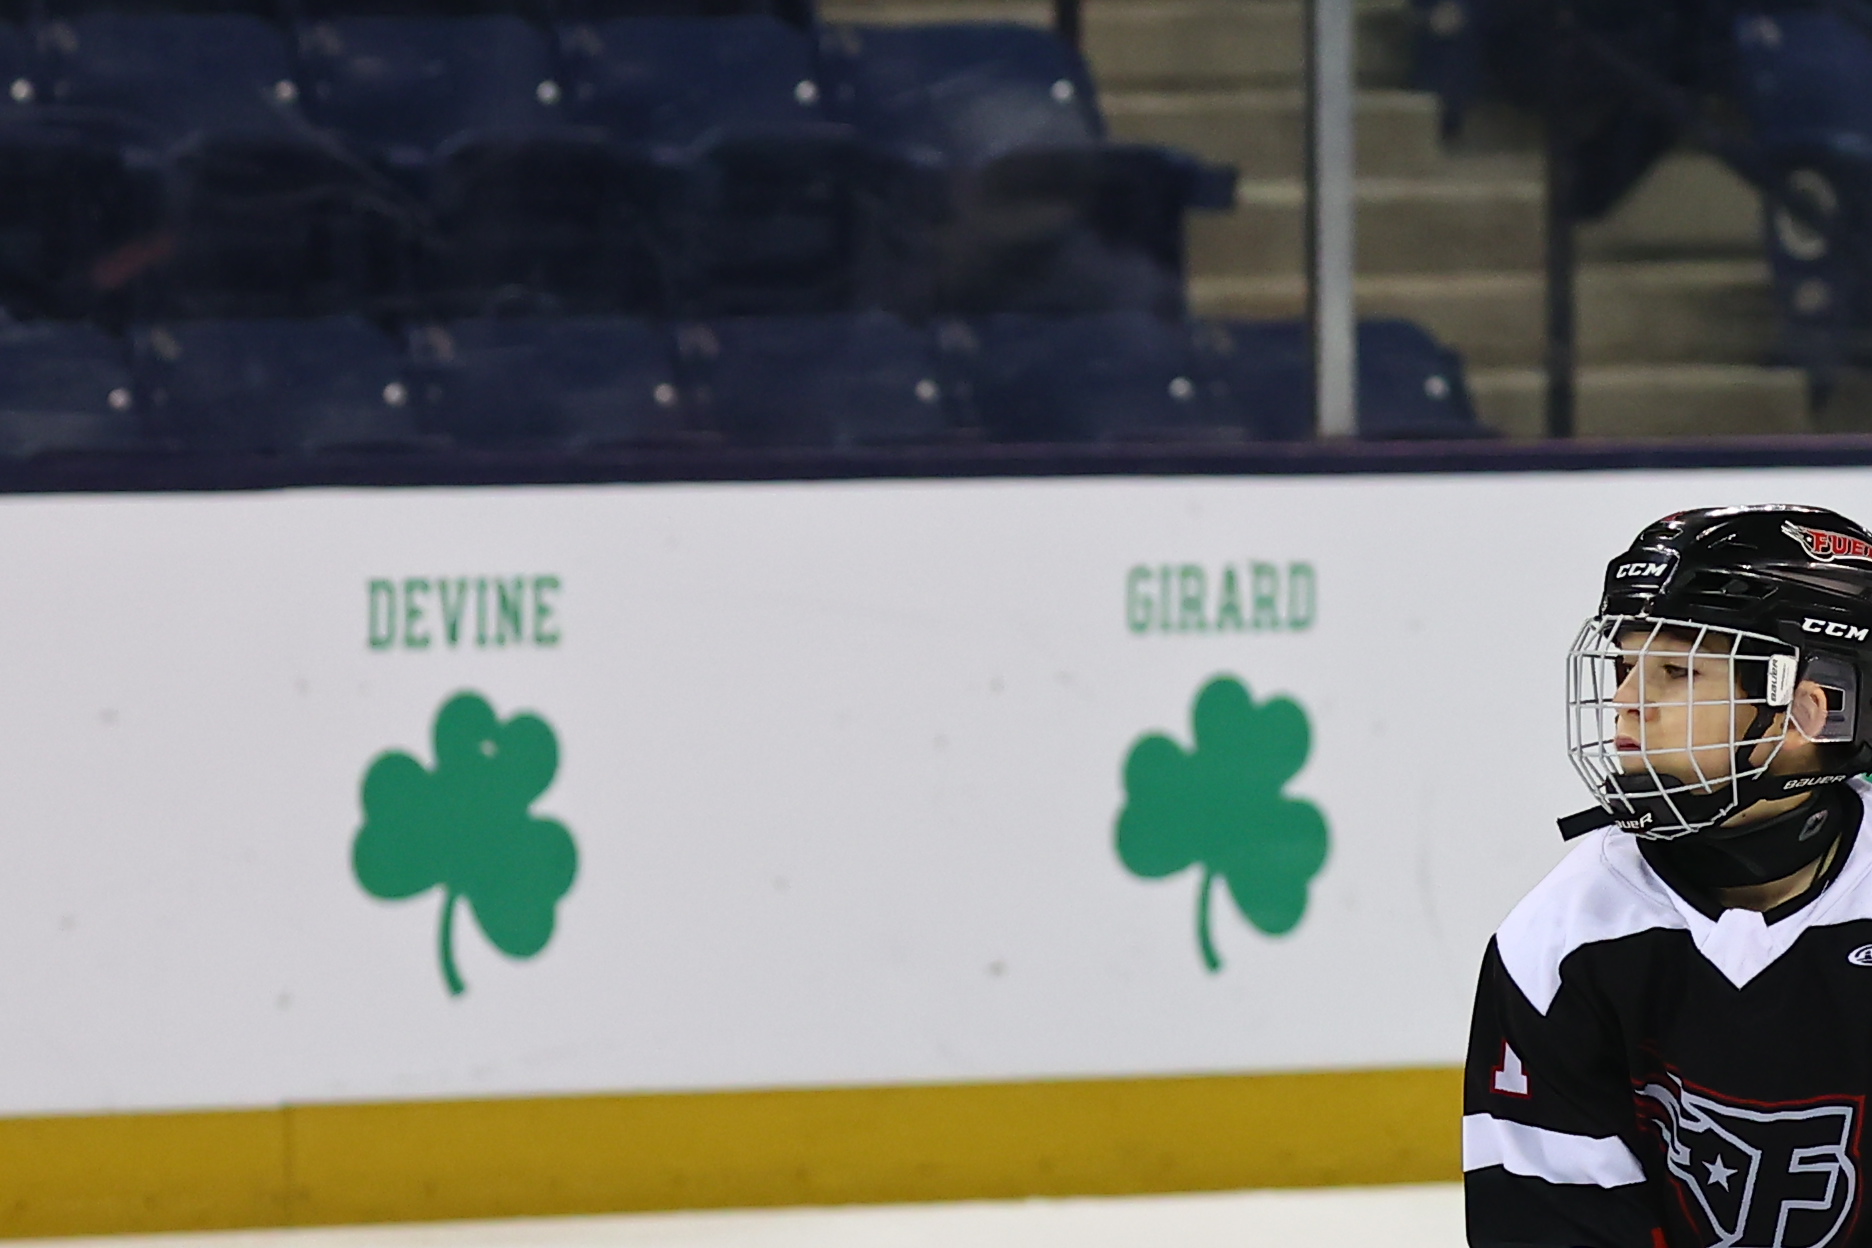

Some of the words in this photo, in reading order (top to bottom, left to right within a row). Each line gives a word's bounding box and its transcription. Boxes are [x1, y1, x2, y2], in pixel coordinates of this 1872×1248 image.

[1616, 562, 1668, 579] CCM
[368, 575, 560, 648] DEVINE
[1126, 562, 1317, 633] GIRARD
[1802, 617, 1869, 641] CCM
